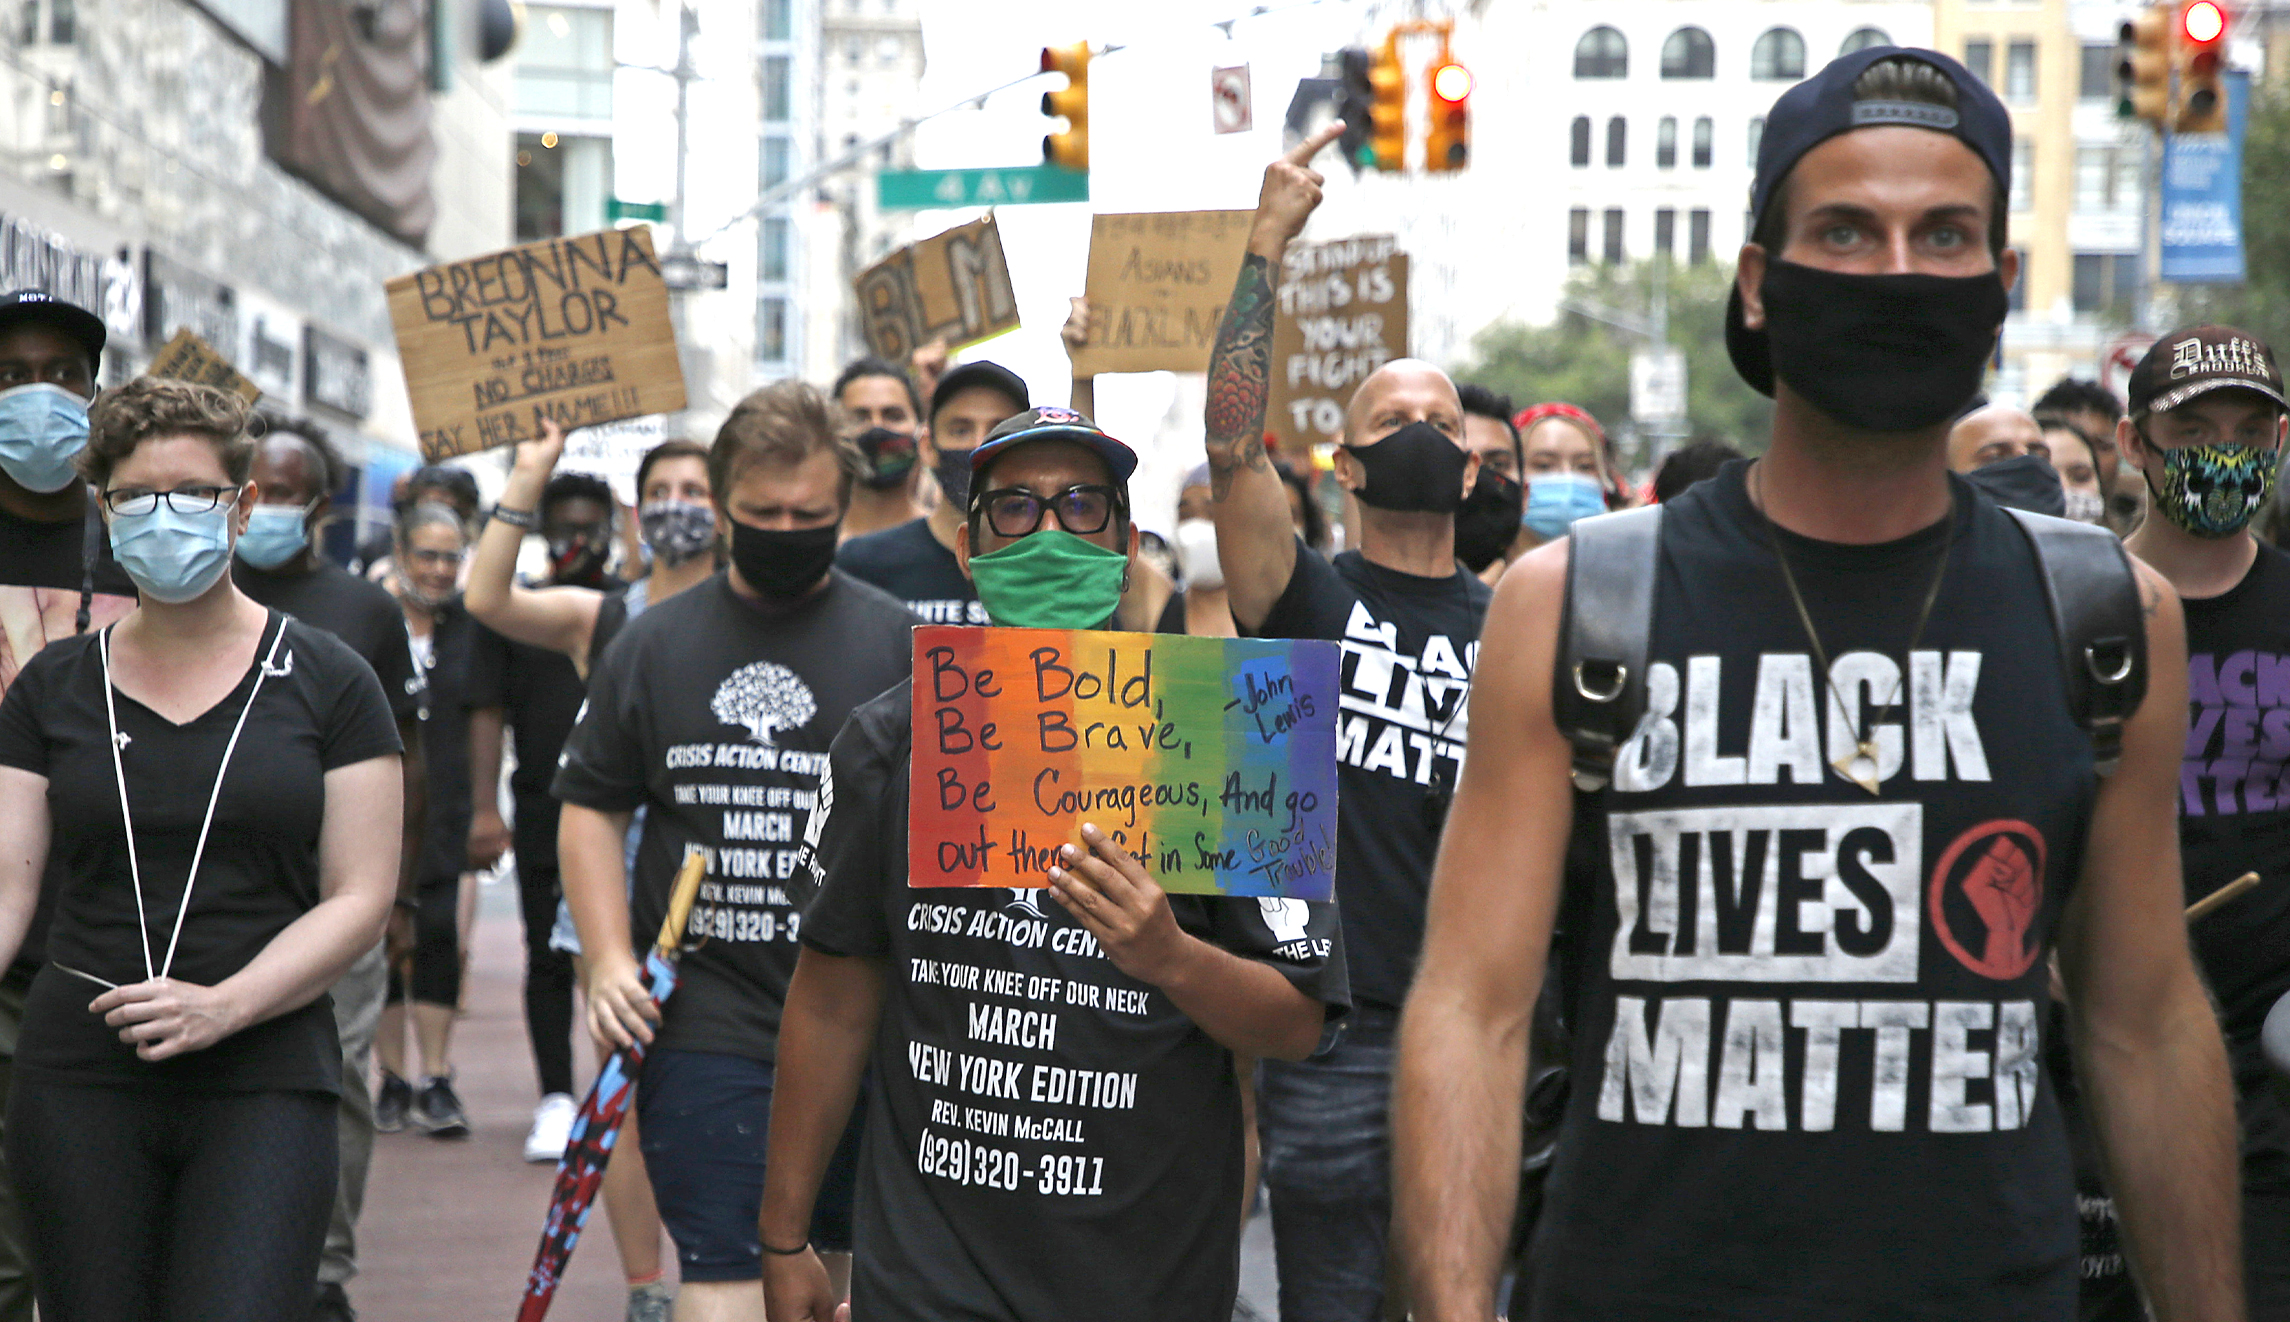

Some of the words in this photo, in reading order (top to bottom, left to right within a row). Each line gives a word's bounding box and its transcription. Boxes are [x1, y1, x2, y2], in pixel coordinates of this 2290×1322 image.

[934, 171, 965, 200] 4
[415, 231, 661, 321] BREONNA
[858, 225, 1014, 366] BLM
[1277, 272, 1352, 315] THIS
[1357, 266, 1394, 303] IS
[448, 286, 629, 355] TAYLOR
[1297, 311, 1384, 350] YOUR
[472, 377, 509, 412] NO
[1287, 348, 1392, 390] FIGHT
[419, 424, 464, 464] SAY
[476, 411, 526, 449] HER
[1289, 397, 1343, 435] TO
[925, 646, 1003, 702] Be
[1030, 646, 1164, 720] Bold,
[934, 706, 1004, 756] Be
[1037, 709, 1192, 760] Brave,
[1254, 693, 1316, 744] Lewis
[1611, 649, 1993, 794] BLACK
[665, 742, 714, 770] CRISIS
[714, 742, 779, 771] ACTION
[779, 749, 830, 776] CENT
[698, 784, 731, 805] YOUR
[732, 785, 766, 807] KNEE
[766, 787, 792, 808] OFF
[936, 766, 998, 812] Be
[1033, 767, 1208, 828] Courageous,
[1219, 770, 1277, 818] And
[1281, 791, 1318, 833] go
[722, 809, 792, 842] MARCH
[938, 824, 998, 873] out
[1160, 840, 1182, 874] in
[1194, 831, 1242, 870] Some
[1246, 817, 1305, 863] Good
[719, 847, 773, 879] YORK
[1248, 822, 1333, 889] Trouble!
[726, 884, 766, 905] KEVIN
[1628, 825, 1897, 958] LIVES
[907, 902, 967, 936] CRISIS
[966, 909, 1049, 949] ACTION
[1050, 927, 1111, 961] CEN
[1272, 940, 1311, 961] THE
[941, 963, 980, 991] YOUR
[983, 968, 1025, 998] KNEE
[1027, 976, 1062, 1002] OFF
[1065, 980, 1100, 1009] OUR
[1105, 987, 1150, 1016] NECK
[967, 1002, 1058, 1051] MARCH
[959, 1053, 1024, 1100] YORK
[1030, 1065, 1138, 1109] EDITION
[1597, 994, 2040, 1133] MATTER
[931, 1099, 961, 1127] REV.
[965, 1107, 1009, 1137] KEVIN
[1013, 1114, 1085, 1143] McCALL
